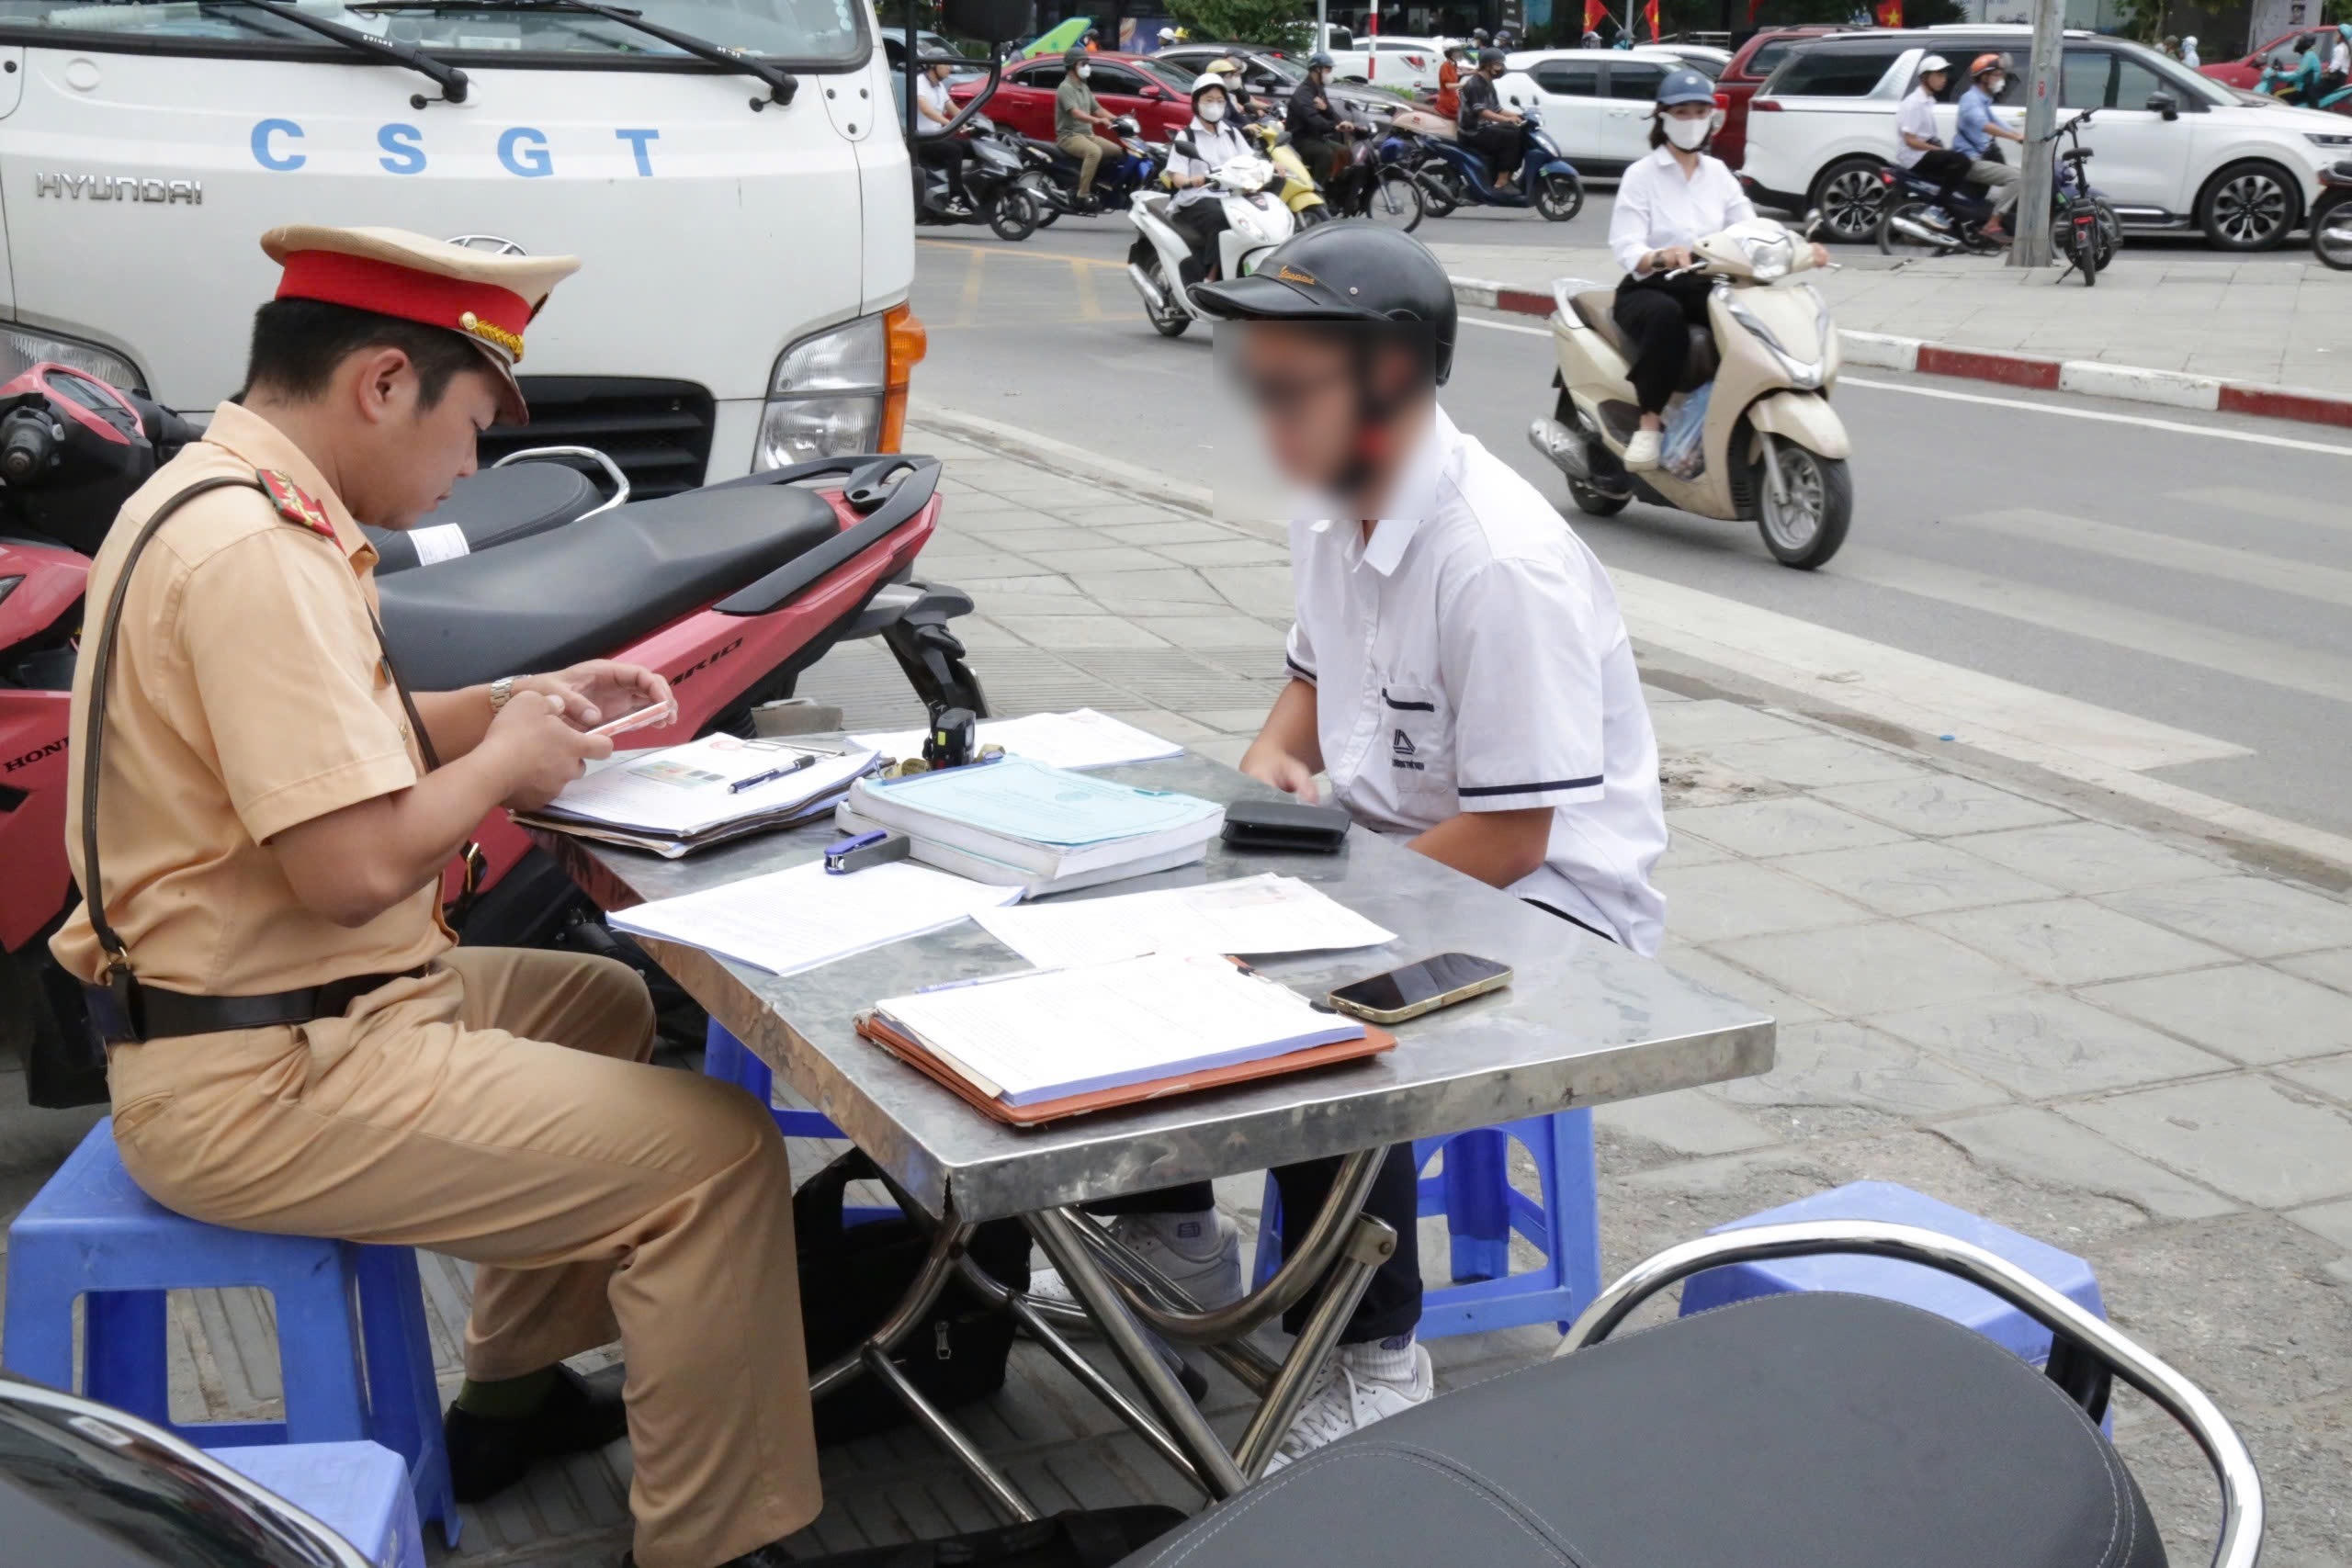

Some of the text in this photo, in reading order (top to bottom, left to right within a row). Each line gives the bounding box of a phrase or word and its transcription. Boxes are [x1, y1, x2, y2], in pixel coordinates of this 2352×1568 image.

[35, 172, 203, 206] HYUNDAI
[668, 637, 743, 687] ARIO
[3, 736, 70, 773] HON
